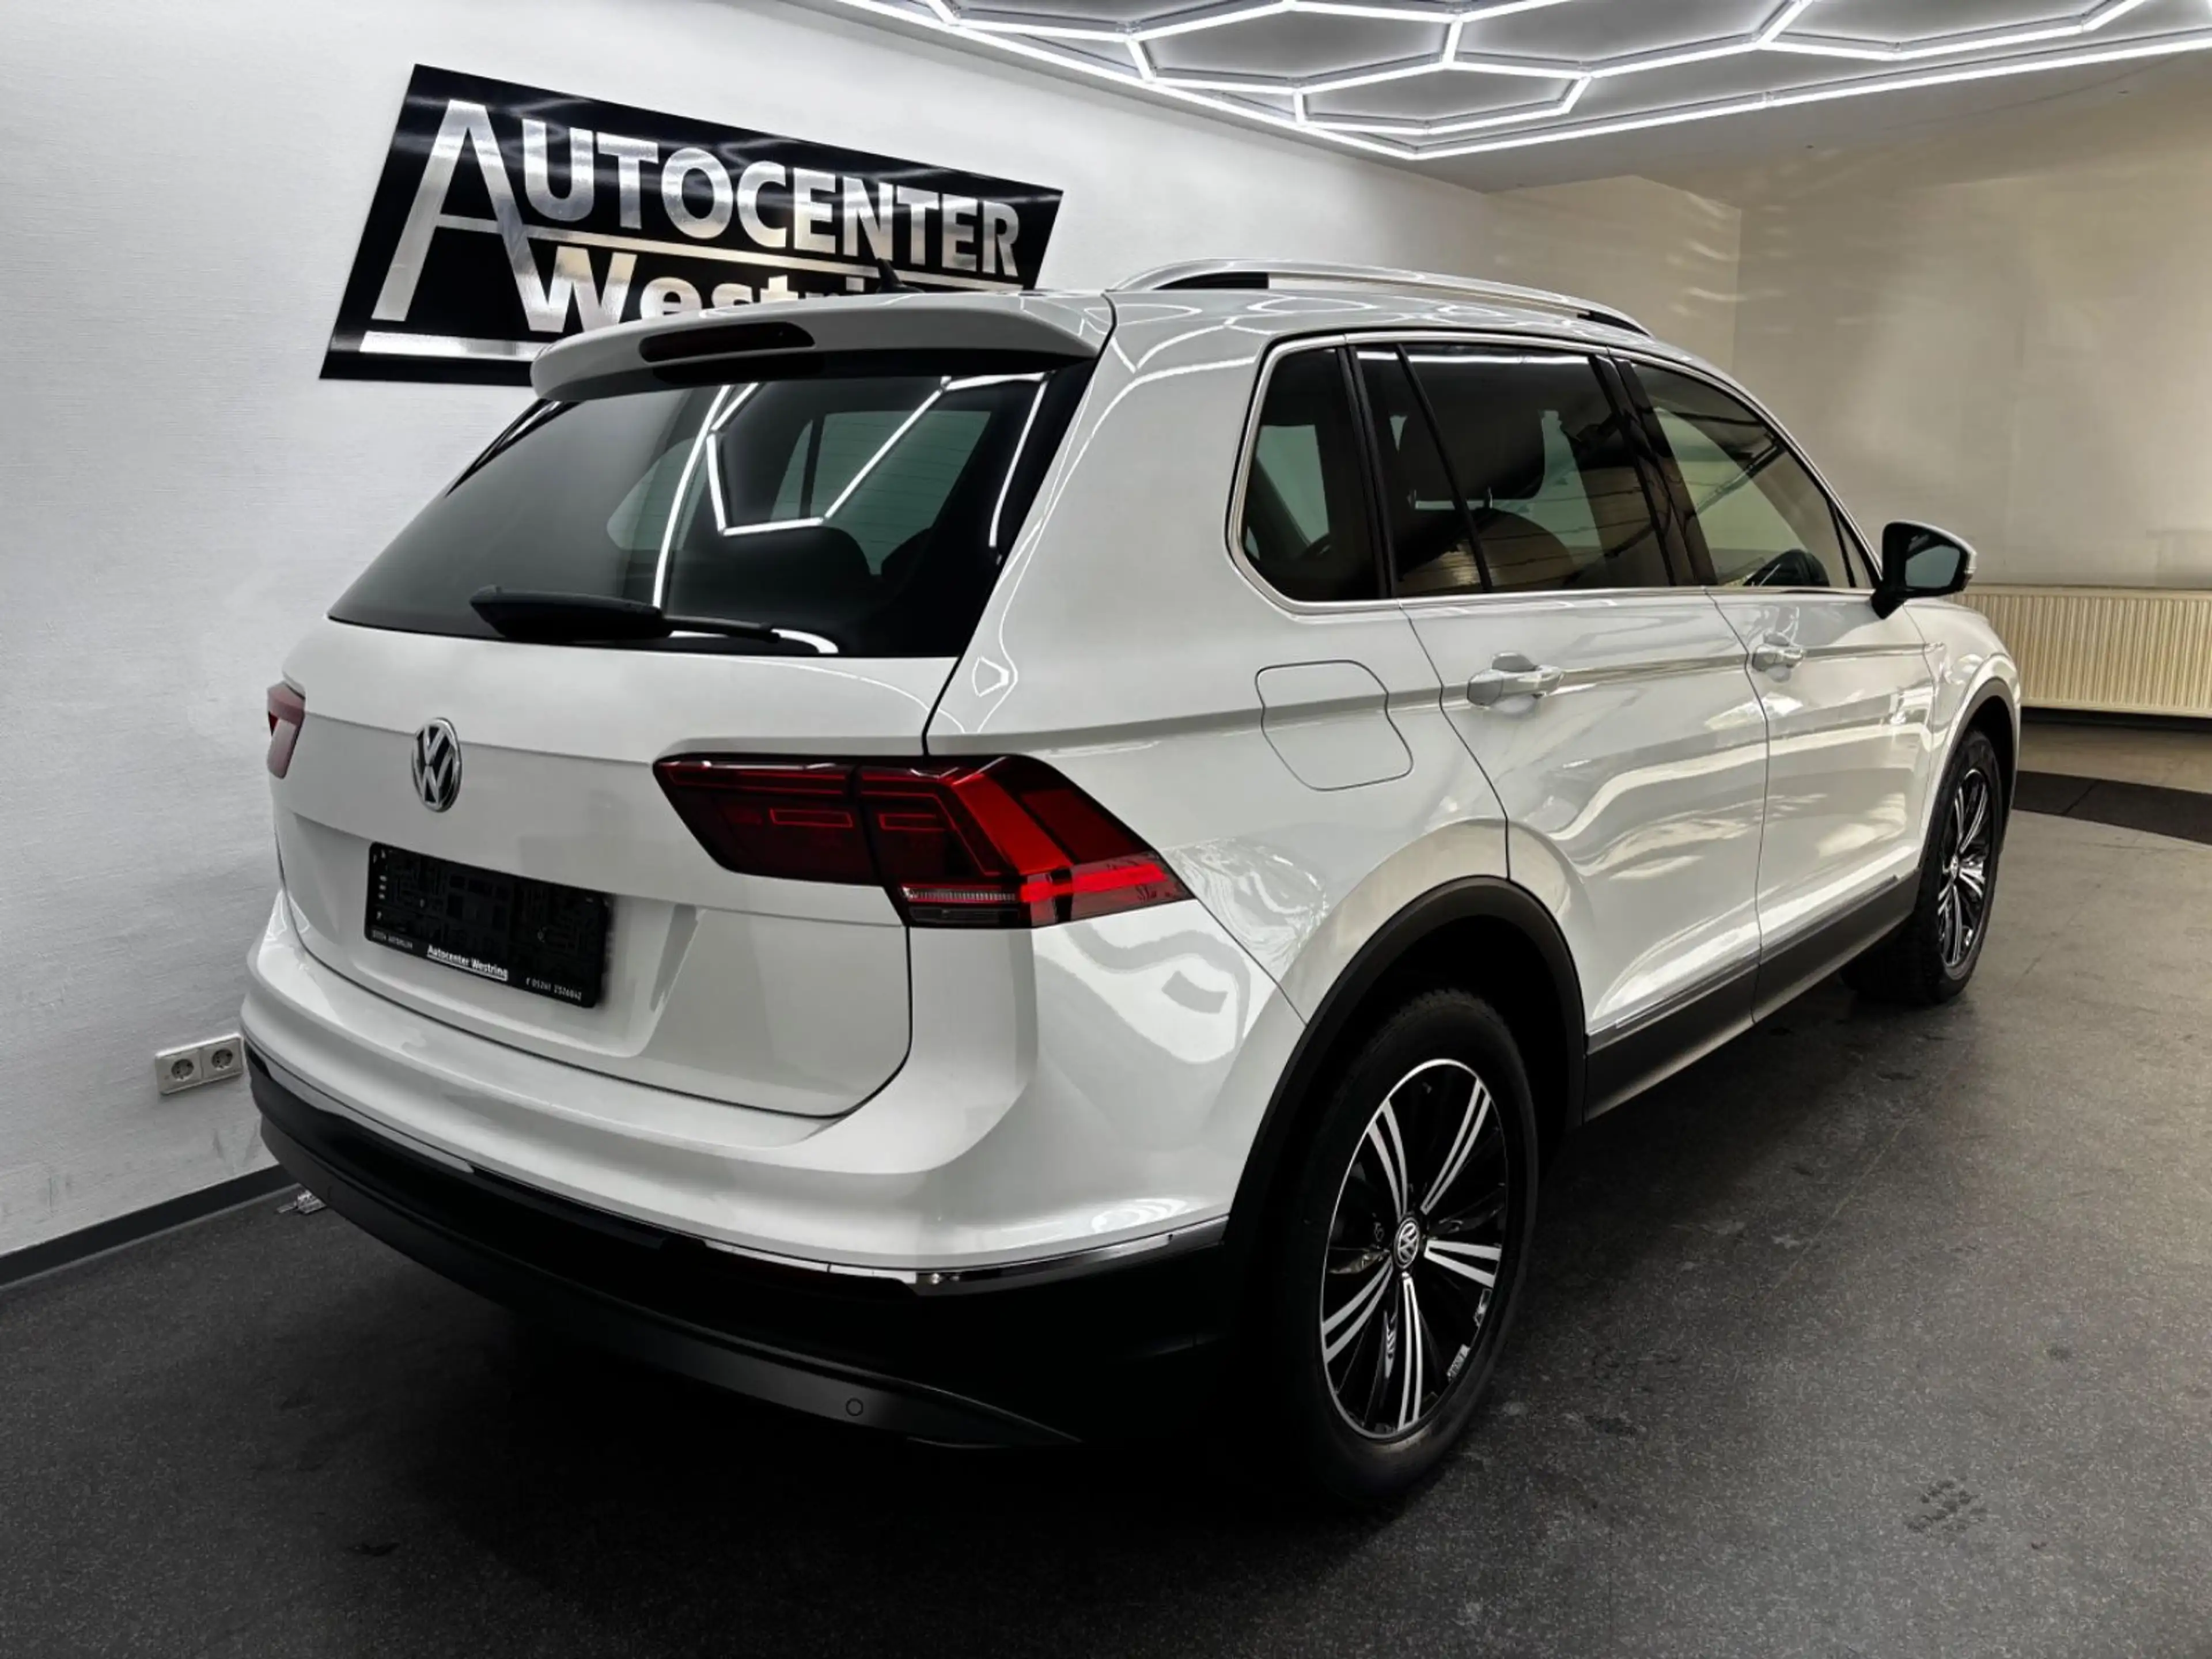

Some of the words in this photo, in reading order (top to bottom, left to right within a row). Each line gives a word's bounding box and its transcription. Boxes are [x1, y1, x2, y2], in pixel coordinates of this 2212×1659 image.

[372, 100, 1020, 321] AUTOCENTER
[427, 944, 469, 966] Autocenter
[471, 957, 509, 979] Westring
